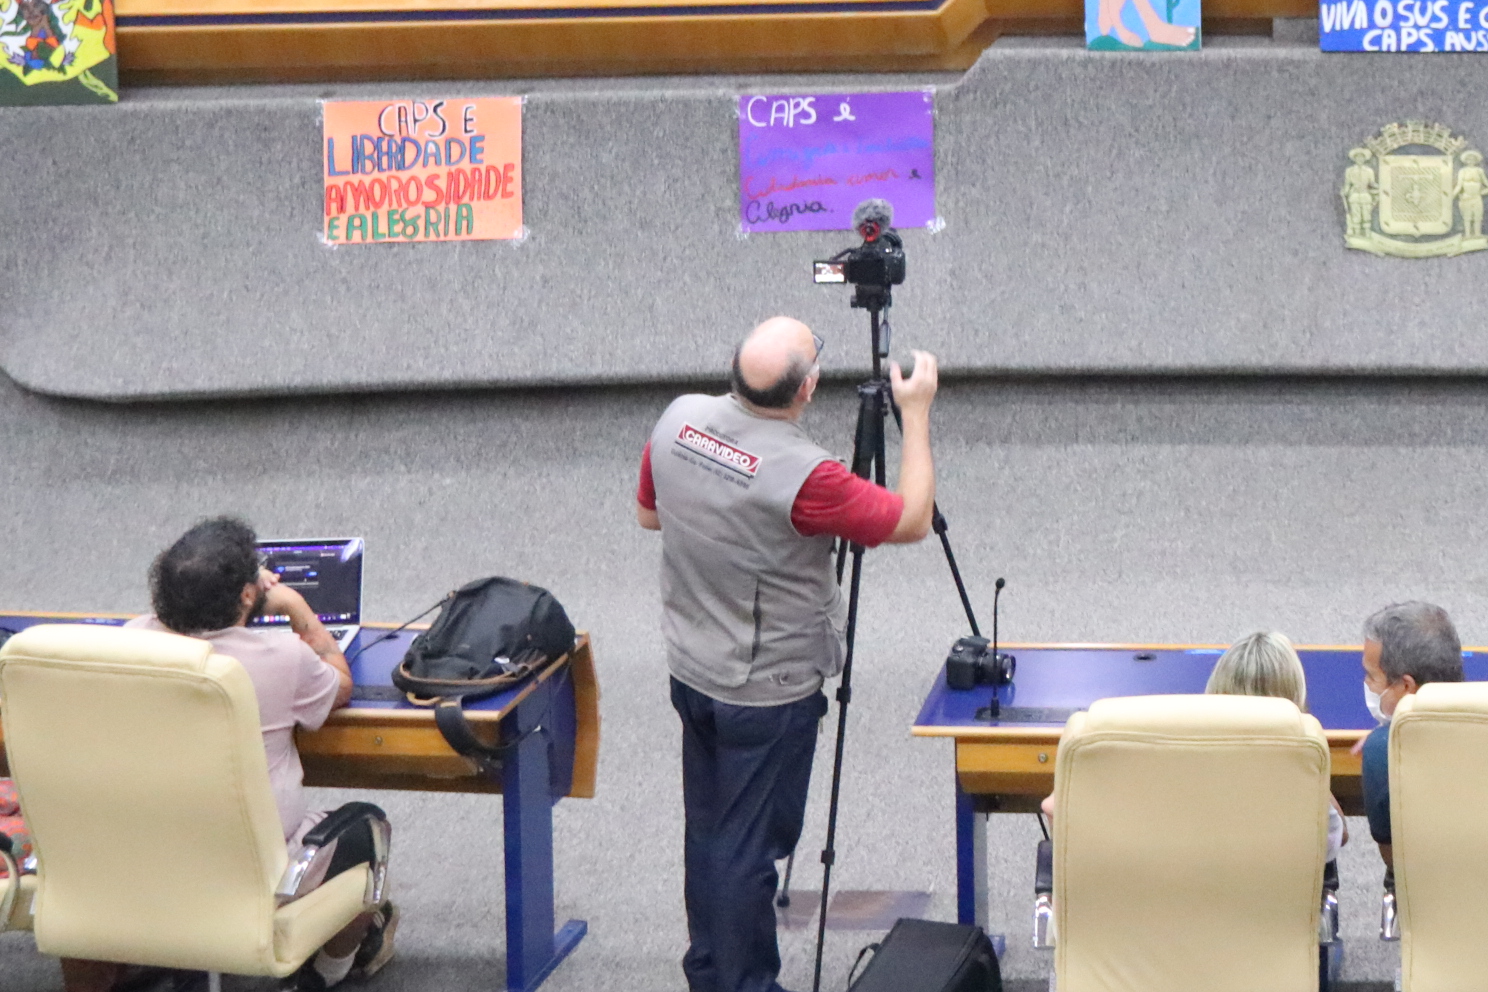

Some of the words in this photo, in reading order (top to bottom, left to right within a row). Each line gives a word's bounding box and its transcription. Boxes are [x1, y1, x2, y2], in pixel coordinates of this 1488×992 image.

[1321, 0, 1368, 33] VIVA
[378, 100, 446, 139] CAPS
[463, 104, 476, 134] E
[747, 95, 817, 128] CAPS
[327, 133, 486, 176] LIBERDADE
[325, 163, 515, 216] AMOROSIDADE
[327, 216, 340, 240] E
[346, 203, 474, 241] ALEGRIA
[684, 428, 751, 468] CARAVIDEO
